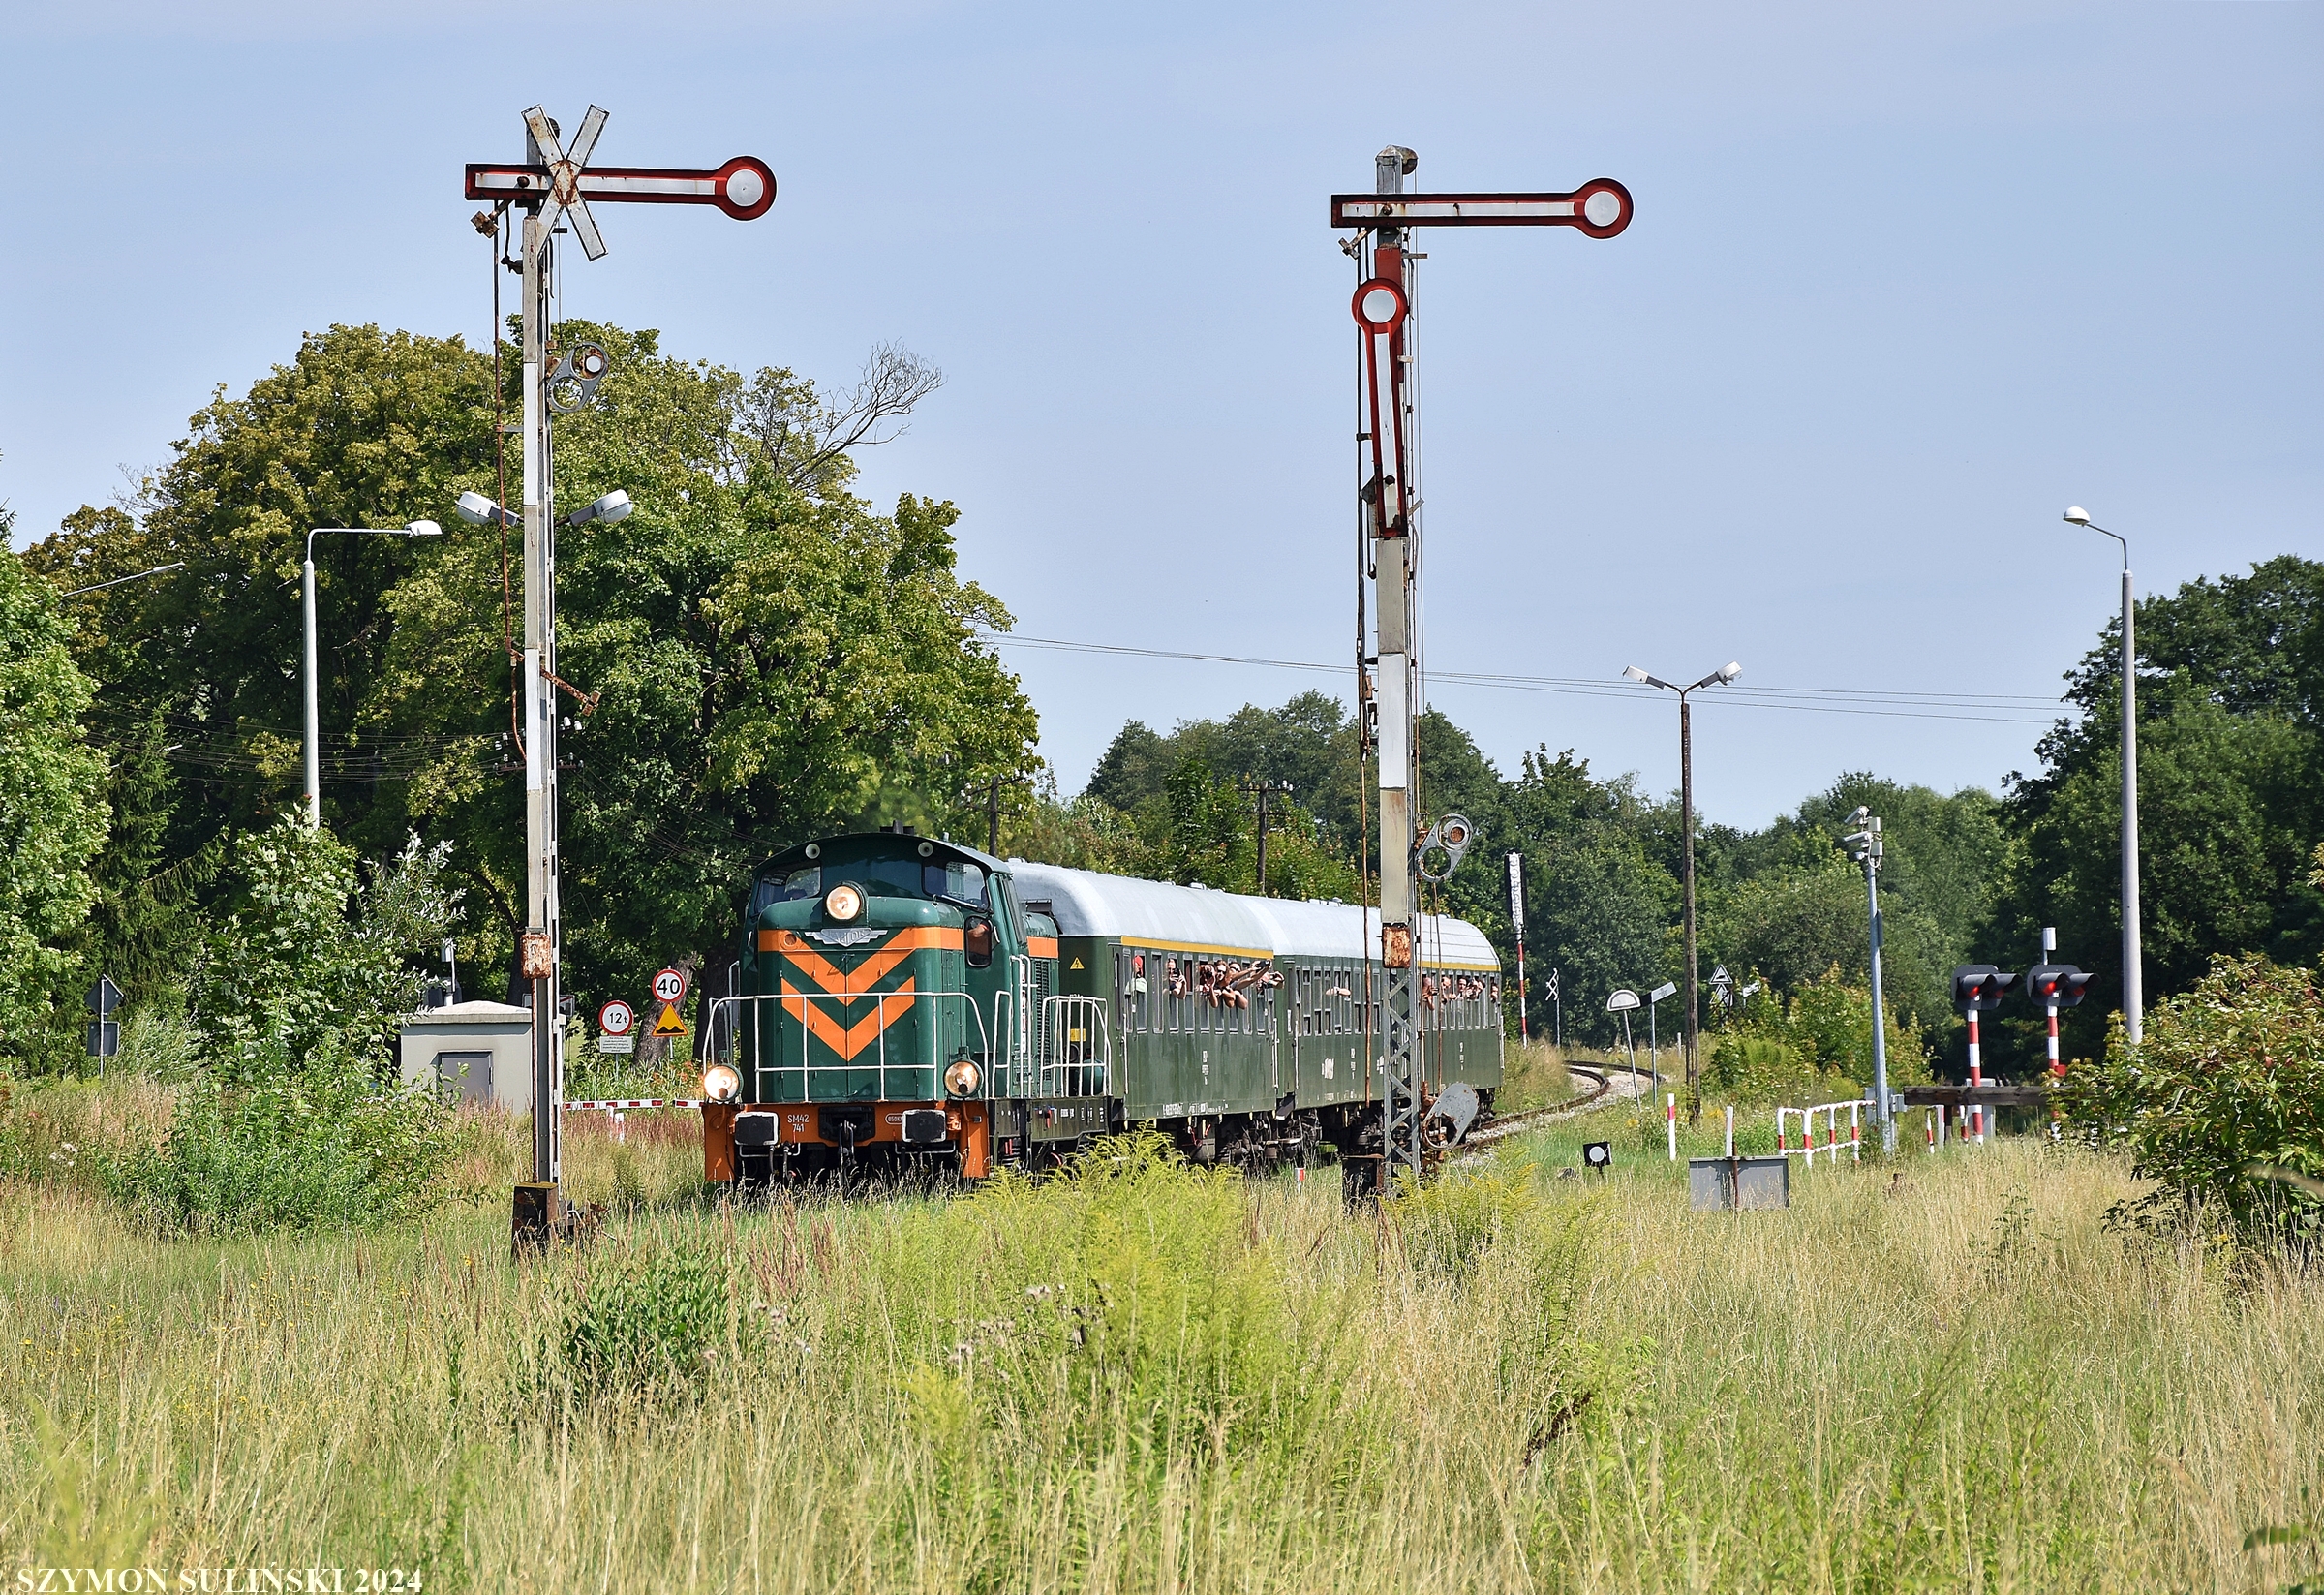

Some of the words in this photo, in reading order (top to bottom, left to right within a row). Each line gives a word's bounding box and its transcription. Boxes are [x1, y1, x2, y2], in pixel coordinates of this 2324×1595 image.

[657, 978, 680, 995] 40
[787, 1114, 810, 1123] SM42
[792, 1123, 805, 1133] 741
